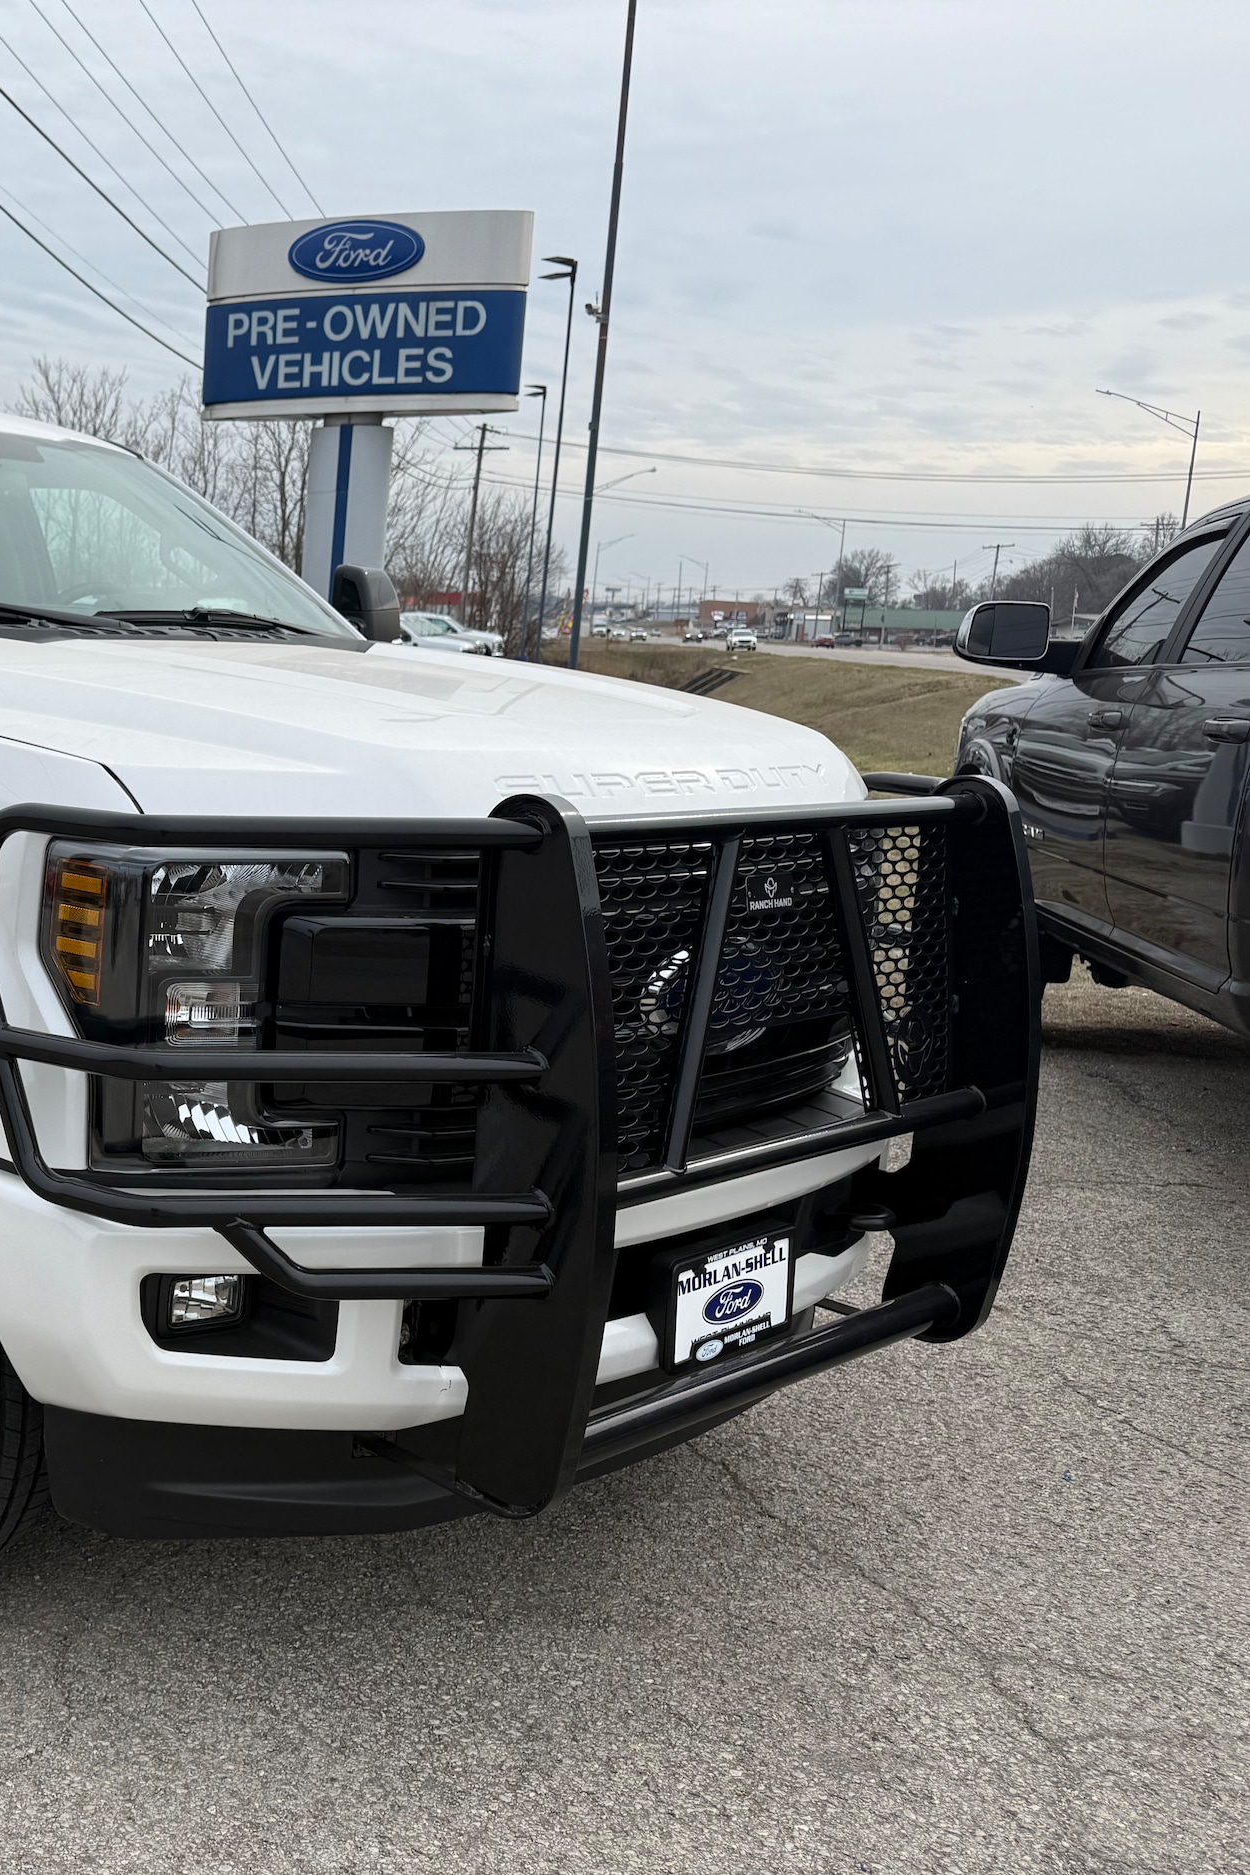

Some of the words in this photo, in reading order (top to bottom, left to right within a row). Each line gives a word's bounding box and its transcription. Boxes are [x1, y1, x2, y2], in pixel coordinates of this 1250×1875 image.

[315, 231, 395, 270] Ford
[226, 300, 488, 349] PRE-OWNED
[250, 346, 454, 391] VEHICLES
[493, 770, 717, 800] SUPER
[715, 764, 829, 794] DUTY
[749, 899, 773, 911] RANCH
[774, 897, 793, 908] HAND
[678, 1247, 786, 1296] MORLAN-SHELL
[707, 1250, 729, 1263] WEST
[715, 1286, 752, 1318] Ford
[723, 1320, 771, 1345] MORLAN-SHELL
[738, 1334, 756, 1347] FORD
